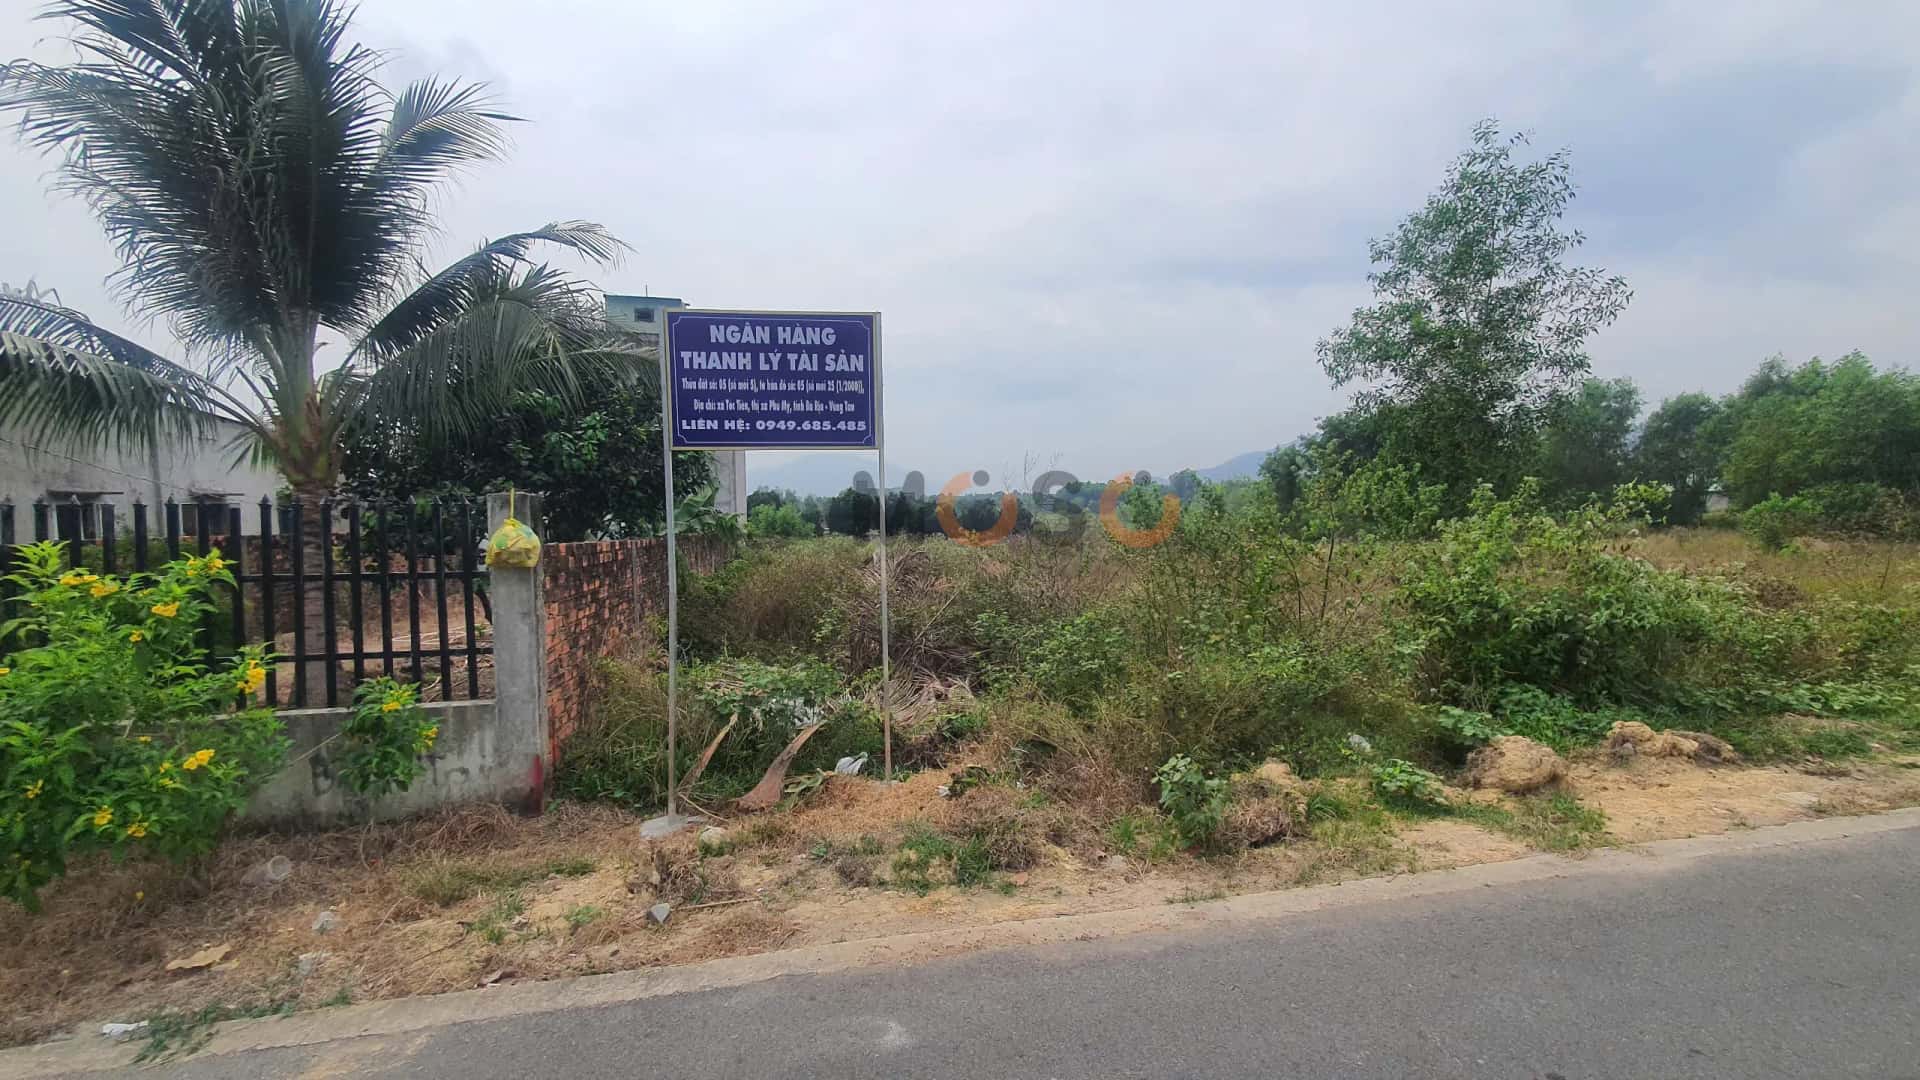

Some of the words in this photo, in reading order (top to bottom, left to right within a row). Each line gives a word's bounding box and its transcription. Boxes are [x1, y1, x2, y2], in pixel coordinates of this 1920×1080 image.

[709, 322, 770, 345] NGÂN
[777, 323, 837, 346] HÀNG
[680, 351, 752, 370] THANH
[759, 348, 781, 371] LÝ
[787, 350, 819, 371] TÀI
[824, 349, 864, 372] SẢN
[681, 417, 718, 430] LIÊN
[724, 417, 751, 432] HỆ:
[755, 420, 867, 431] 0949.685.485
